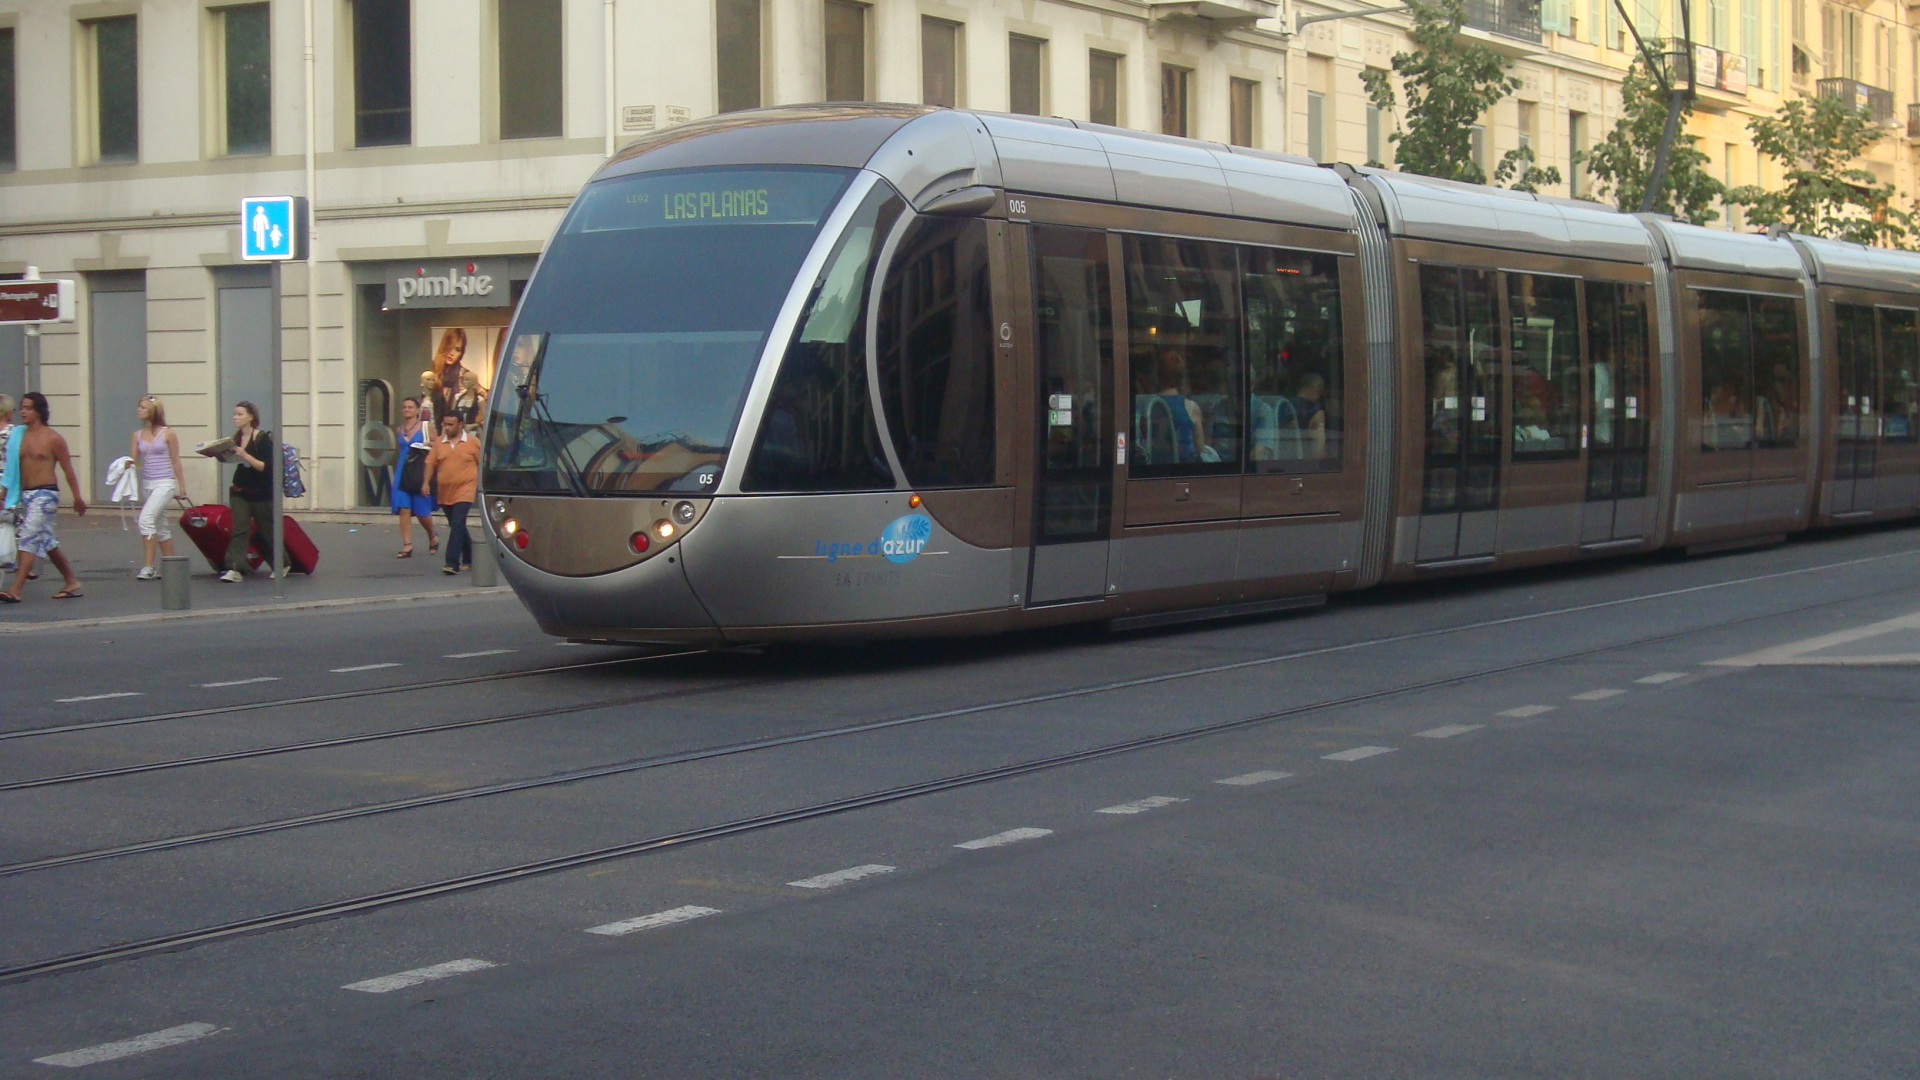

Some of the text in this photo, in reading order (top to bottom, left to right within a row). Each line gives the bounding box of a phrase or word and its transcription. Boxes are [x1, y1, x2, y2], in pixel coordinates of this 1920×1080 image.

[664, 189, 769, 220] LAS PLANAS
[1009, 199, 1027, 214] 005
[397, 262, 494, 305] pimkie
[699, 473, 714, 485] 05
[814, 536, 925, 563] ligne d'azur
